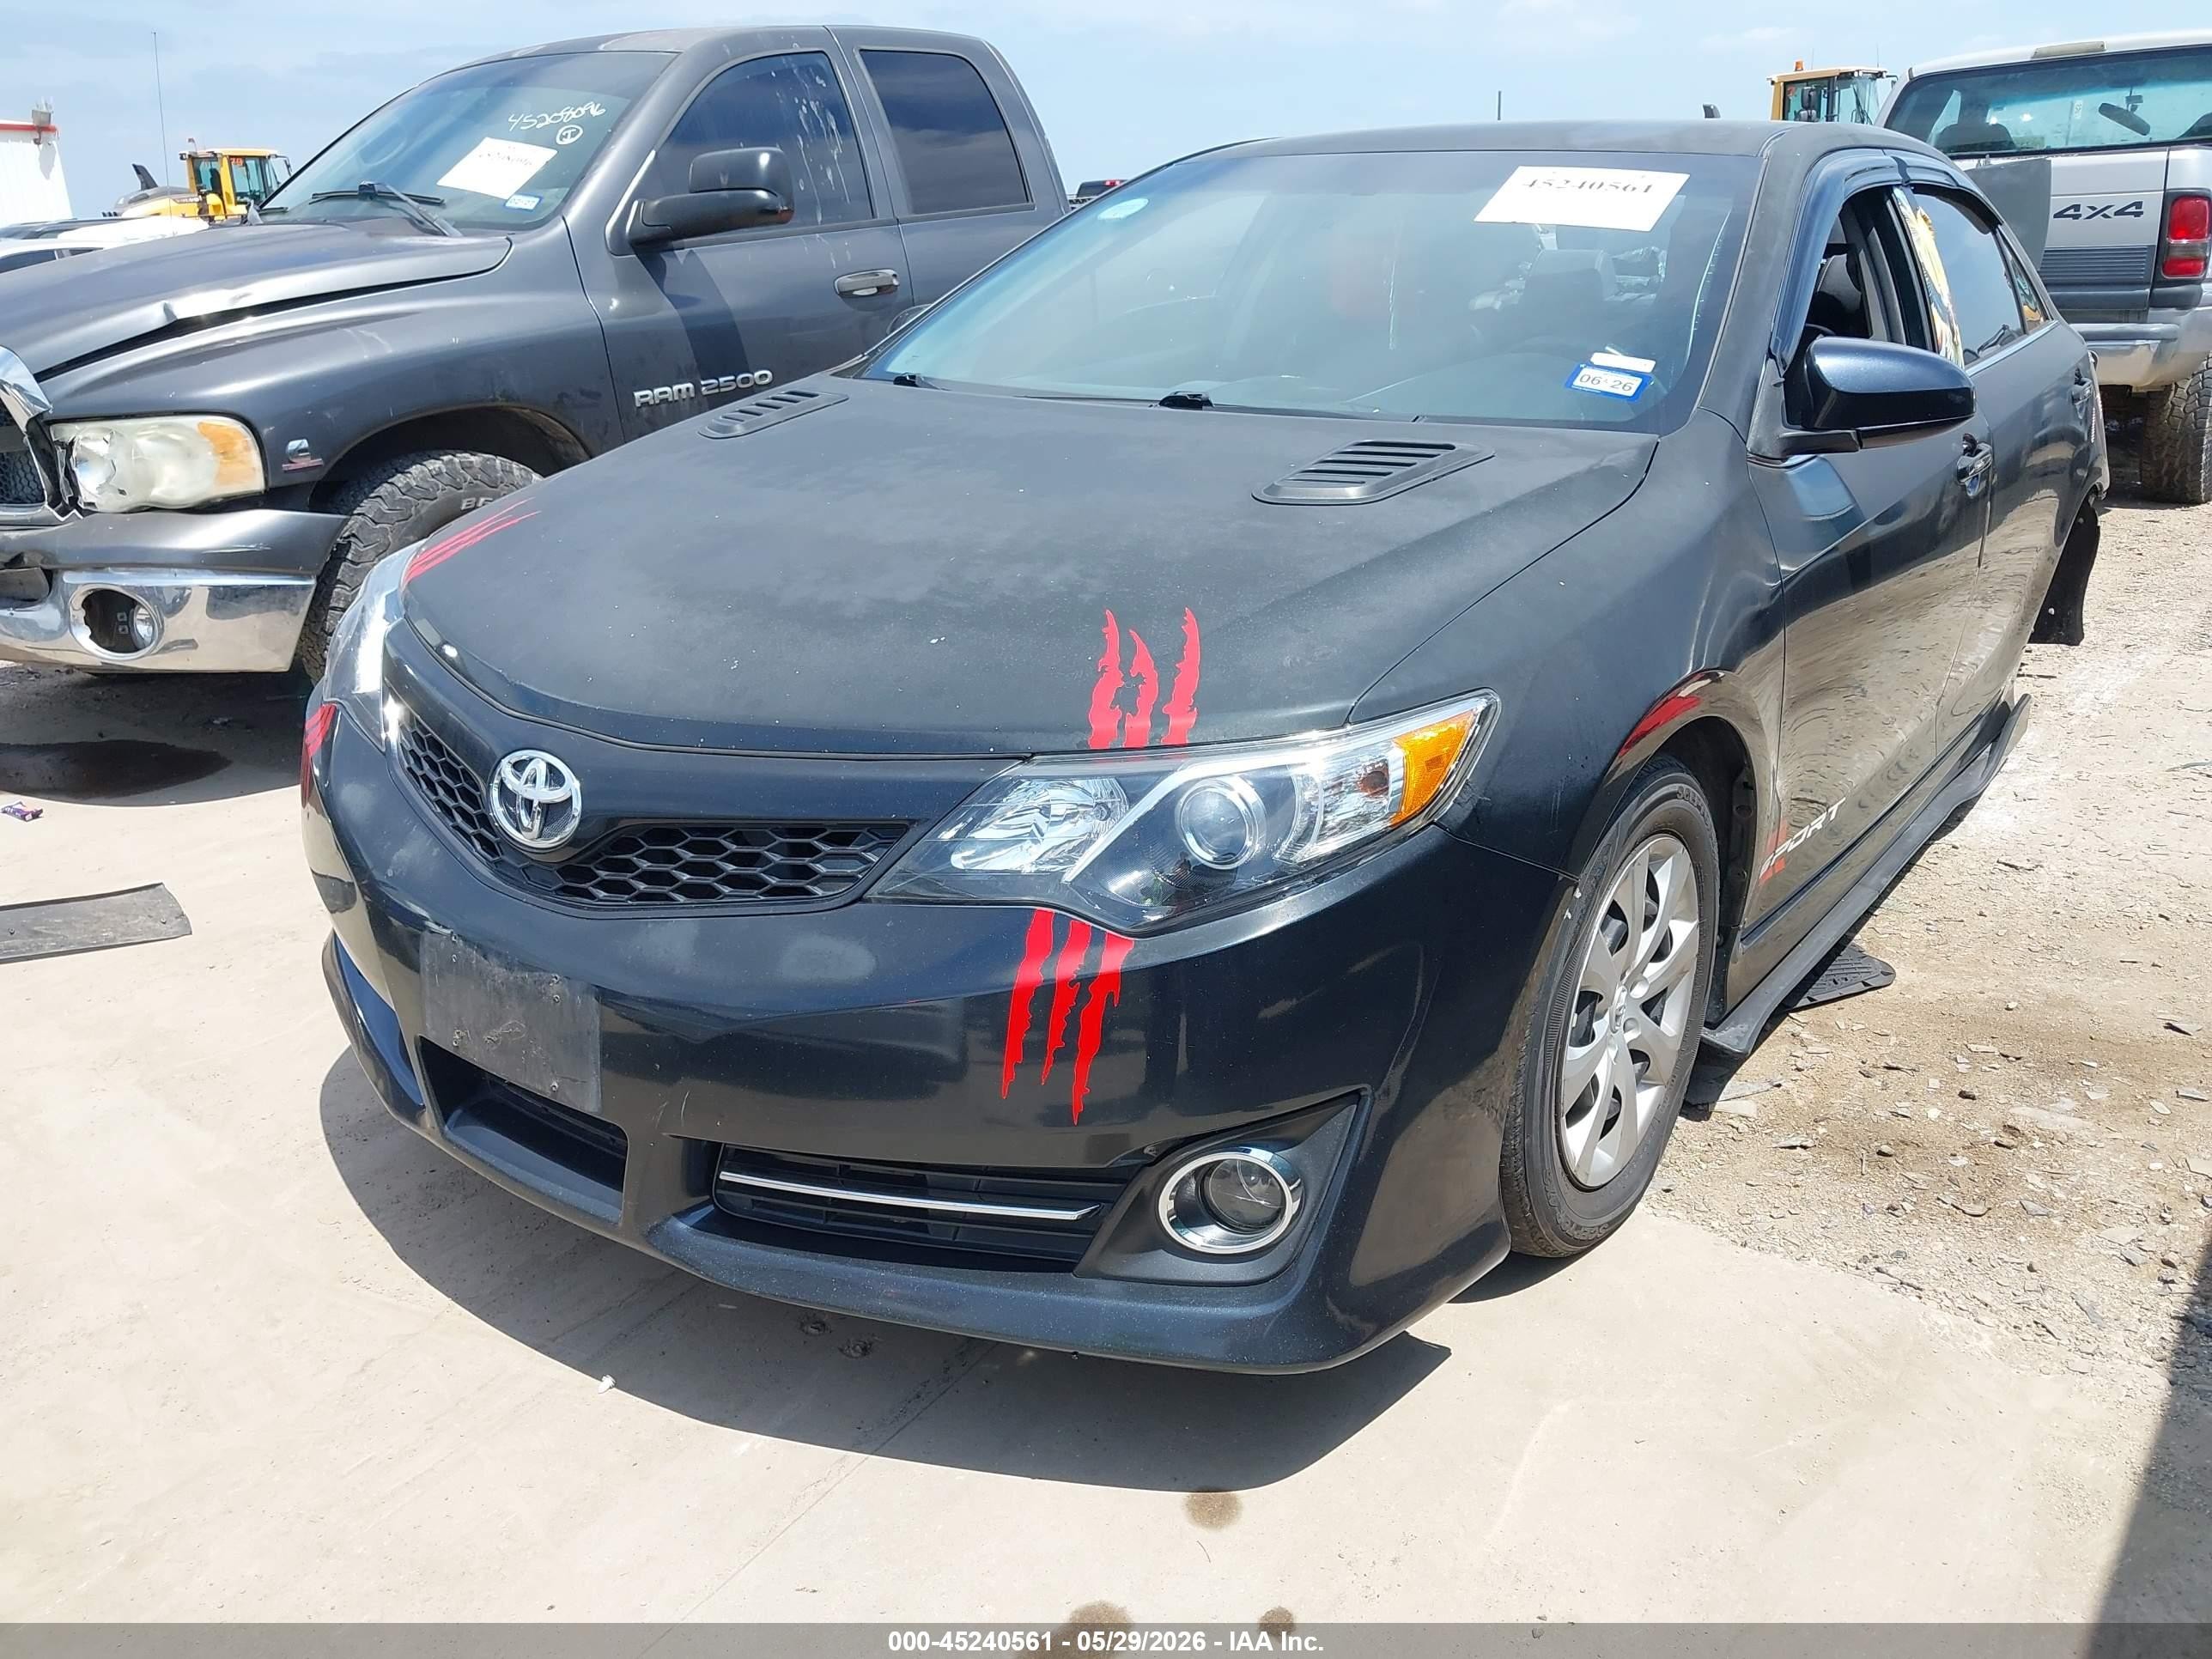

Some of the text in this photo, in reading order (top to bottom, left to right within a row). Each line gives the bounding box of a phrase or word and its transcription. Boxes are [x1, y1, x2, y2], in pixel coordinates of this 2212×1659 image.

[507, 101, 606, 131] 45208096
[1522, 178, 1654, 193] 45240561
[634, 369, 773, 407] RAM 2500
